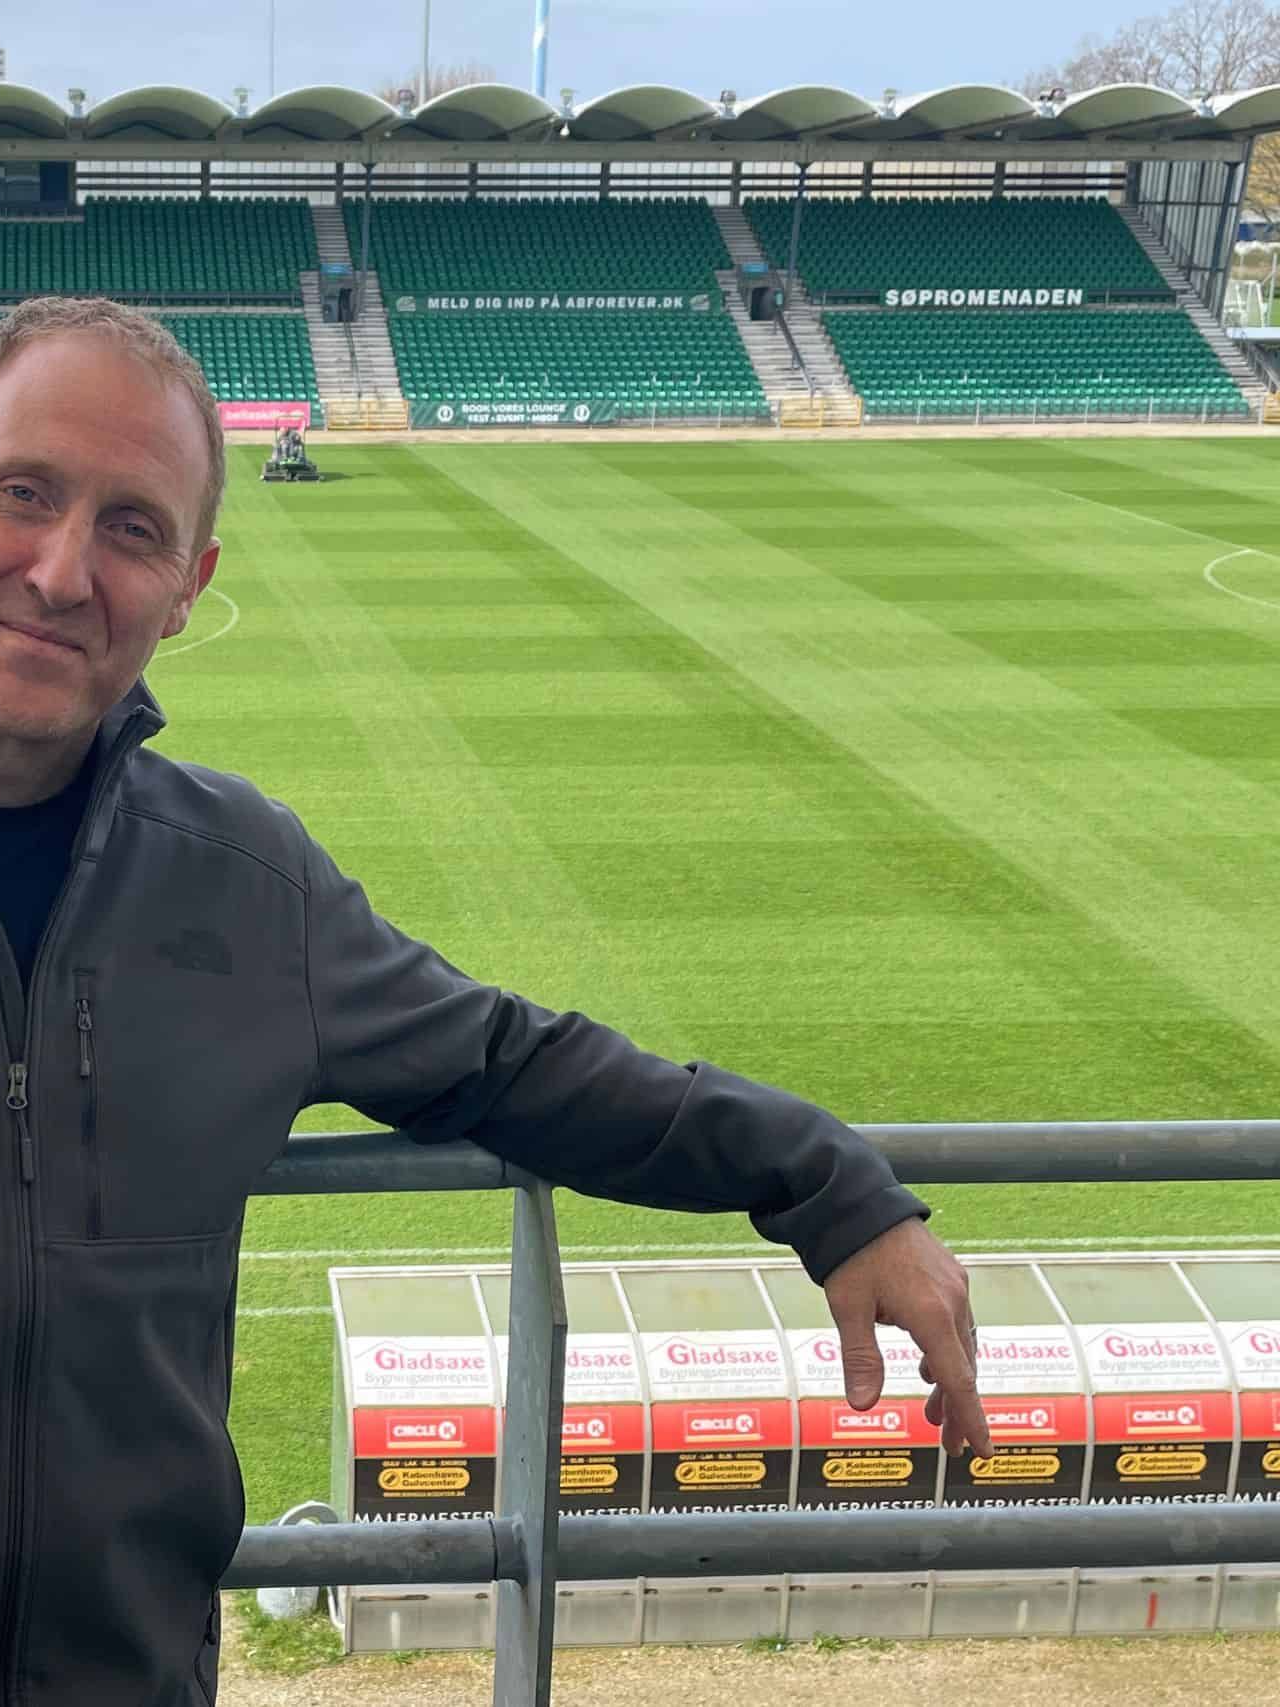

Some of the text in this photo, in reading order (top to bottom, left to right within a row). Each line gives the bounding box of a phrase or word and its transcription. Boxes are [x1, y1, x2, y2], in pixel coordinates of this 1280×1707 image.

[427, 293, 684, 309] MELD DIG IND PÅ ABFOREVER.DK
[885, 288, 1083, 306] SØPROMENADEN
[461, 403, 490, 413] BOOK
[526, 403, 567, 413] LOUNGE
[977, 1342, 1071, 1360] ladsaxe
[1104, 1335, 1216, 1357] Gladsaxe
[374, 1348, 485, 1370] Gladsaxe
[567, 1350, 633, 1368] dsaxe
[667, 1343, 779, 1365] Gladsaxe
[838, 1415, 881, 1427] CIRCLE
[986, 1412, 1029, 1424] CIRCLE
[1133, 1410, 1176, 1422] CIRCLE
[393, 1424, 437, 1437] CIRCLE
[562, 1423, 585, 1434] CLE
[690, 1418, 734, 1431] CIRCLE
